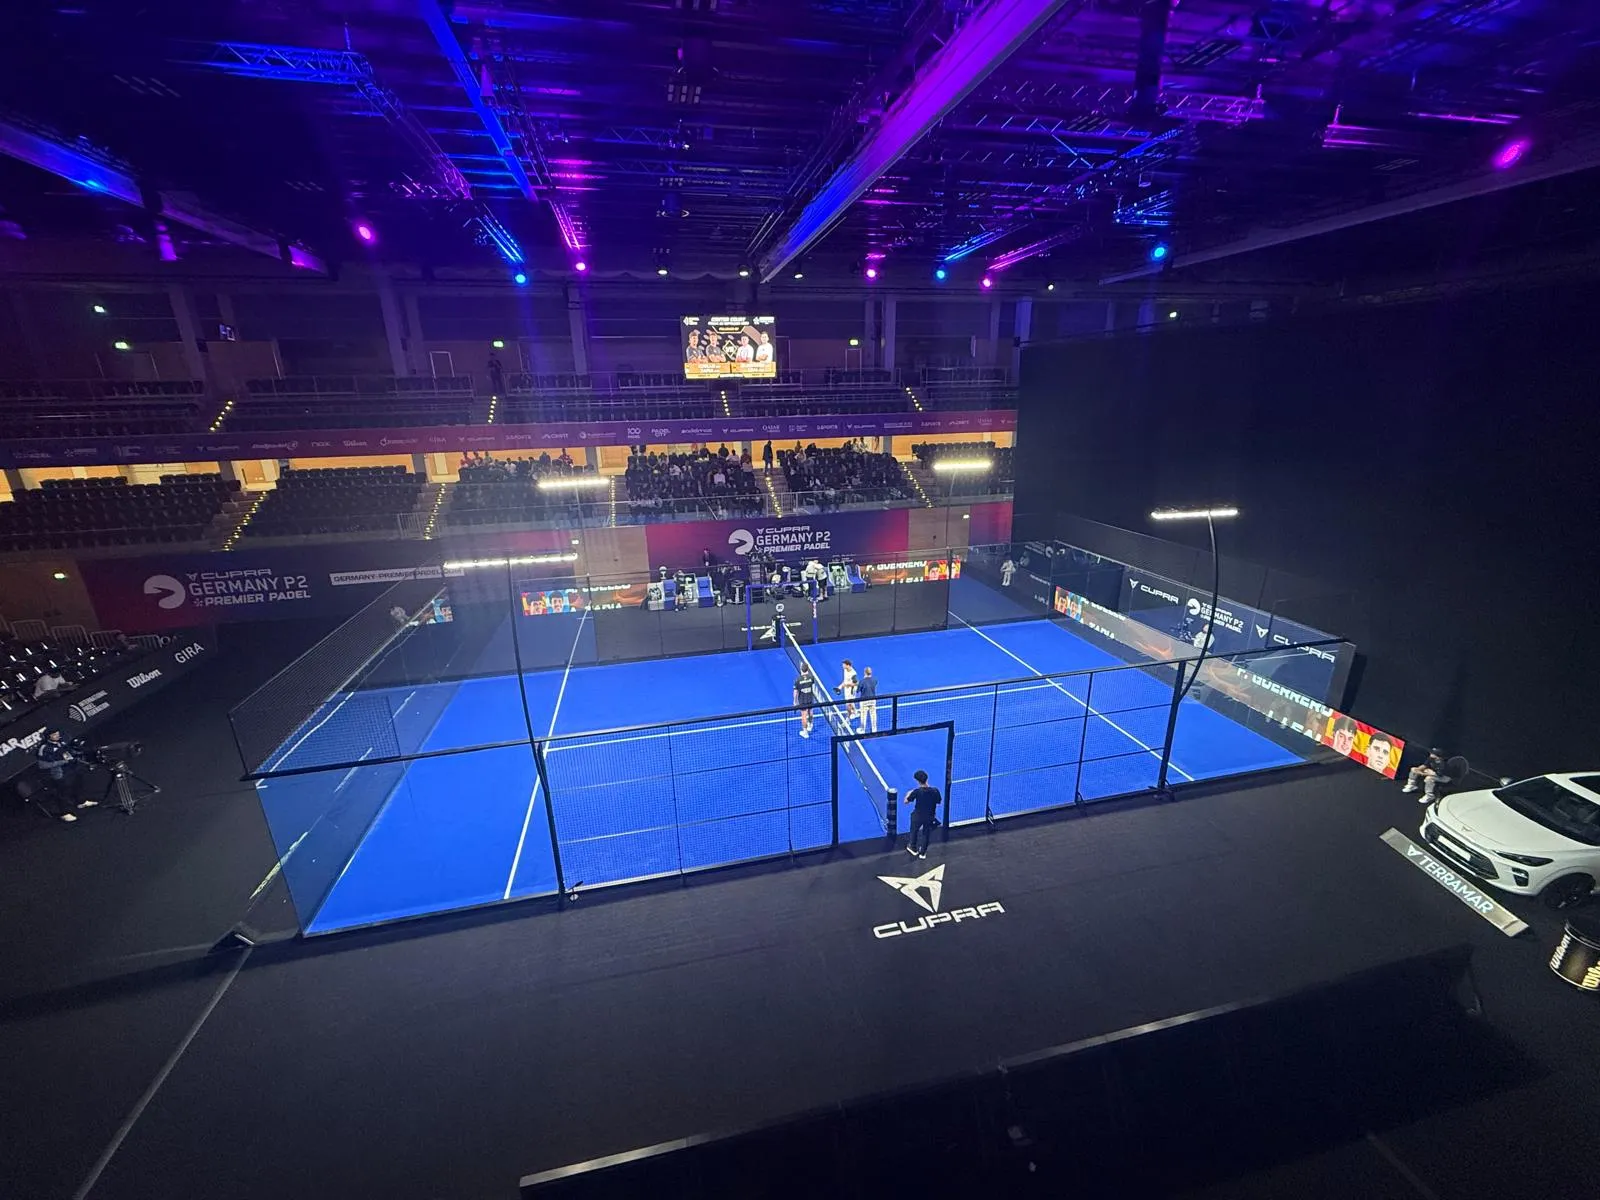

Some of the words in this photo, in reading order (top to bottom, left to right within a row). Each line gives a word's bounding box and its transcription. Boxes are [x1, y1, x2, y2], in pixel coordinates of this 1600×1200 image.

[756, 532, 813, 546] GERMANY
[816, 531, 831, 542] P2
[766, 526, 810, 534] CUPRA
[763, 544, 801, 553] PREMIER
[803, 542, 831, 550] PADEL
[200, 568, 272, 581] CUPRA
[188, 577, 279, 596] GERMANY
[283, 575, 309, 589] P2
[1140, 584, 1179, 604] CUPRA
[204, 593, 264, 607] PREMIER
[269, 590, 311, 602] PADEL
[1200, 606, 1234, 624] GEMANY
[1233, 618, 1244, 629] P2
[174, 642, 205, 664] GIRA
[126, 669, 163, 689] Wilson
[1418, 855, 1495, 914] TERRAMAR
[873, 901, 1006, 939] CUPRA
[1550, 933, 1572, 970] Wilson
